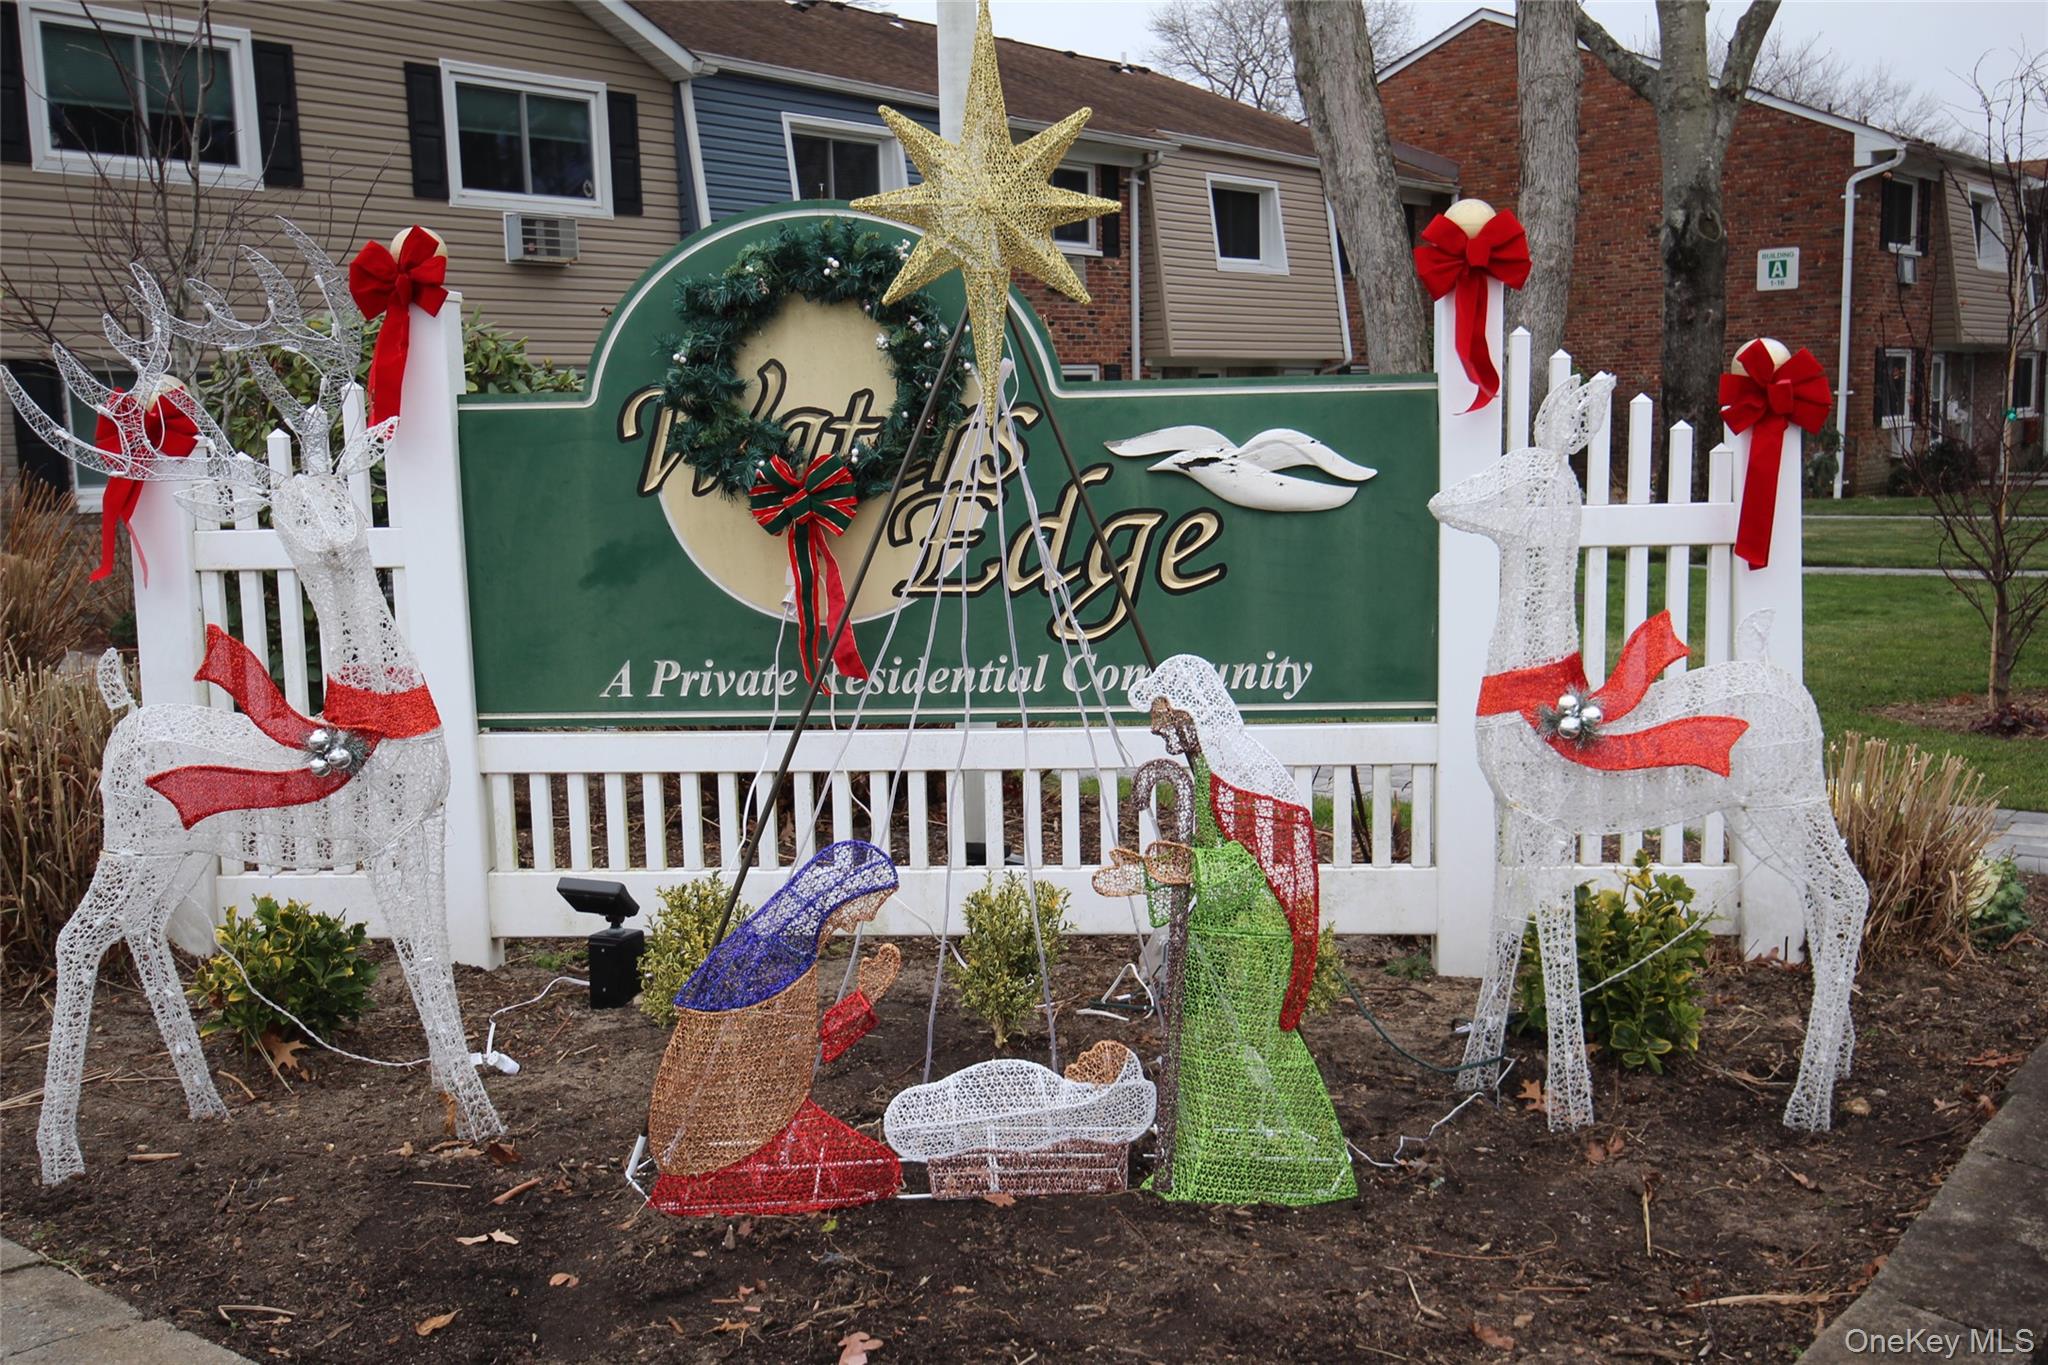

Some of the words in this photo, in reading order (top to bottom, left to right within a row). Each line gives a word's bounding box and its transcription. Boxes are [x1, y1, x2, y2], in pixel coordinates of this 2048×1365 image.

[1761, 251, 1795, 260] BUILDING
[1771, 261, 1785, 278] A
[887, 462, 1228, 646] Edge
[600, 659, 634, 698] A
[647, 658, 798, 698] Private
